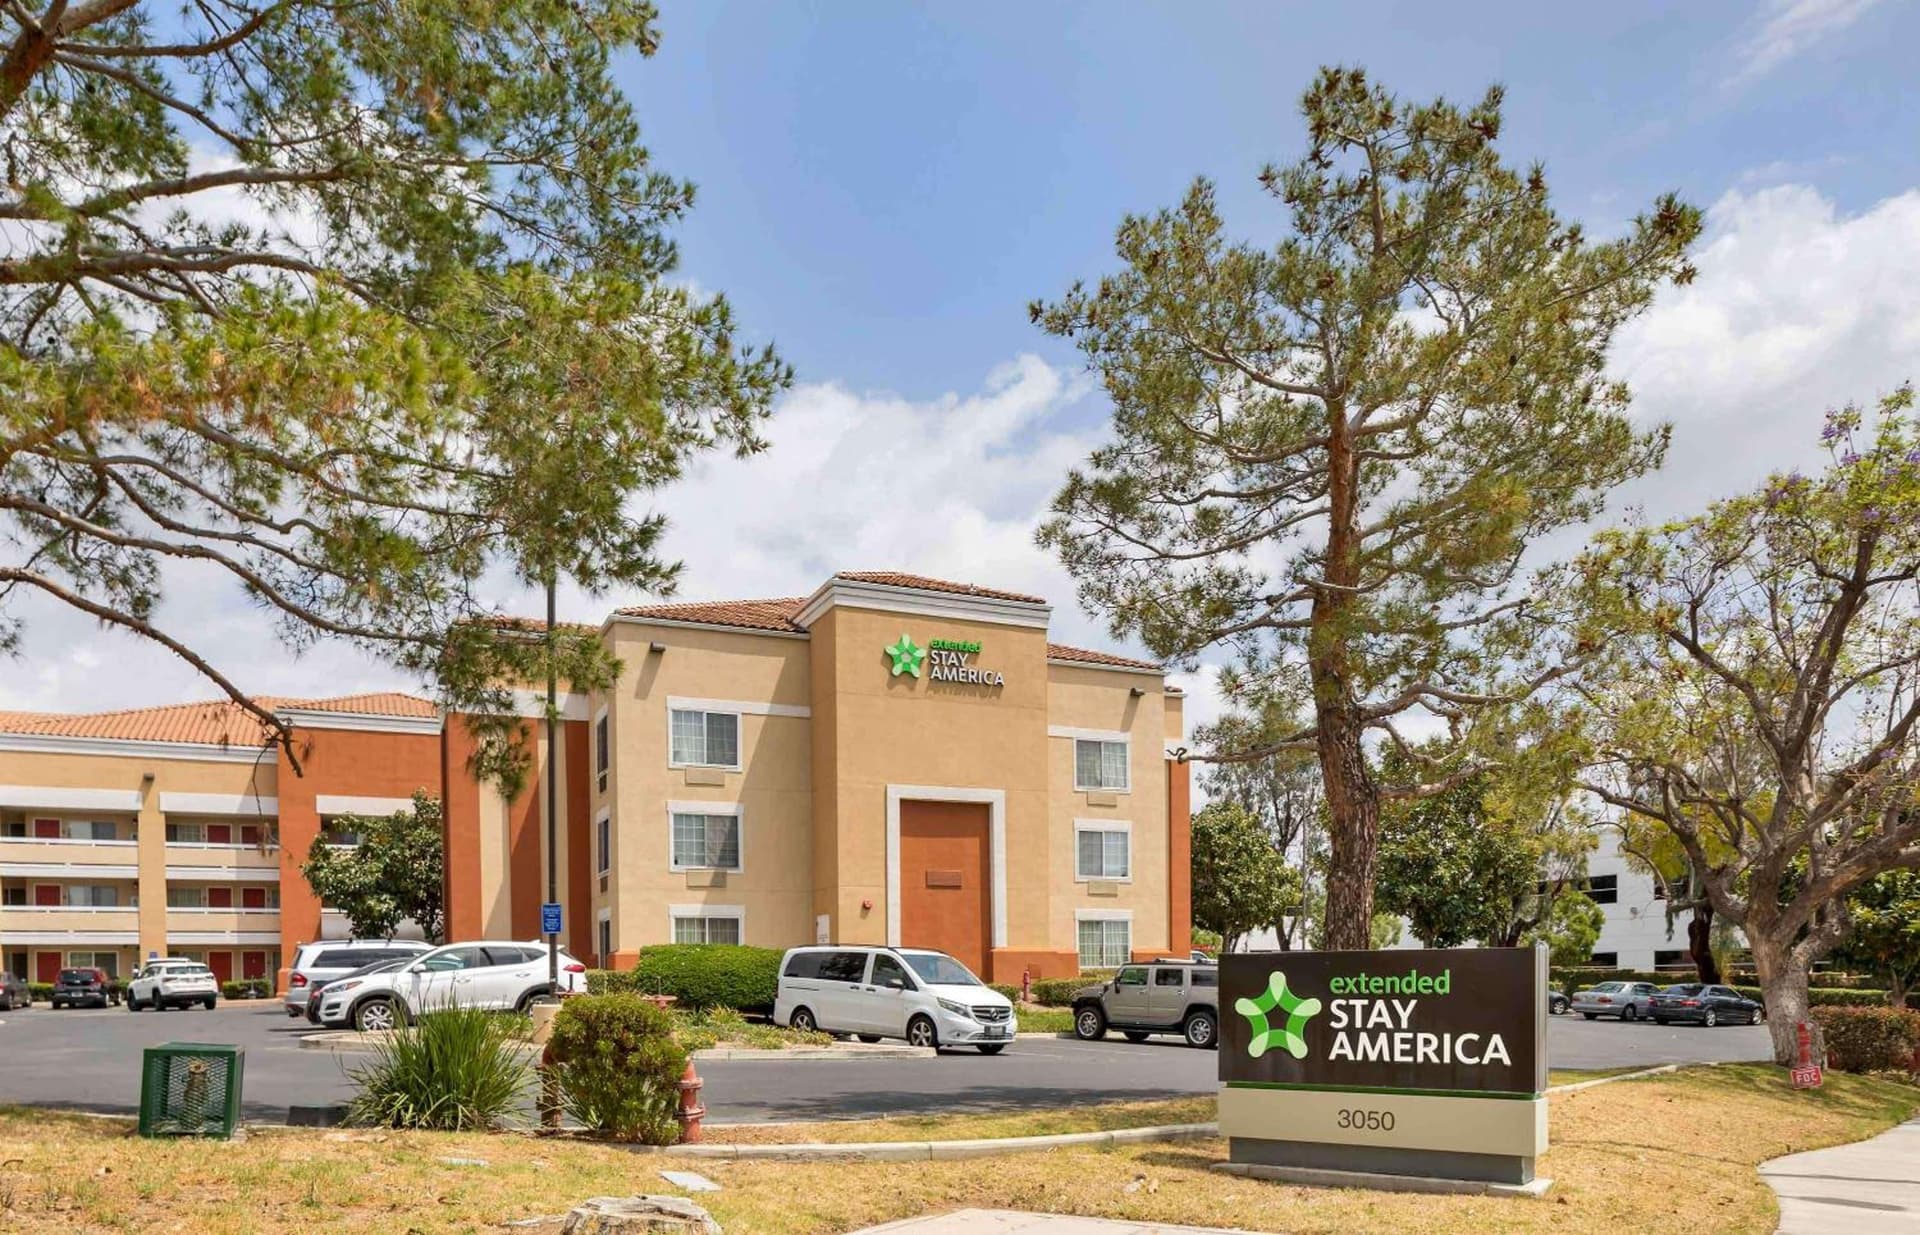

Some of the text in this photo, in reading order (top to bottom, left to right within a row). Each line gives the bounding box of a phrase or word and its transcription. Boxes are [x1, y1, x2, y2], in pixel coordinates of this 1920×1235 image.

[930, 640, 983, 652] extended
[931, 651, 969, 666] STAY
[931, 666, 1005, 685] AMERICA
[1329, 969, 1450, 995] extended
[1329, 999, 1417, 1029] STAY
[1328, 1031, 1511, 1065] AMERICA
[1796, 1072, 1818, 1083] FDC
[1337, 1109, 1396, 1131] 3050
